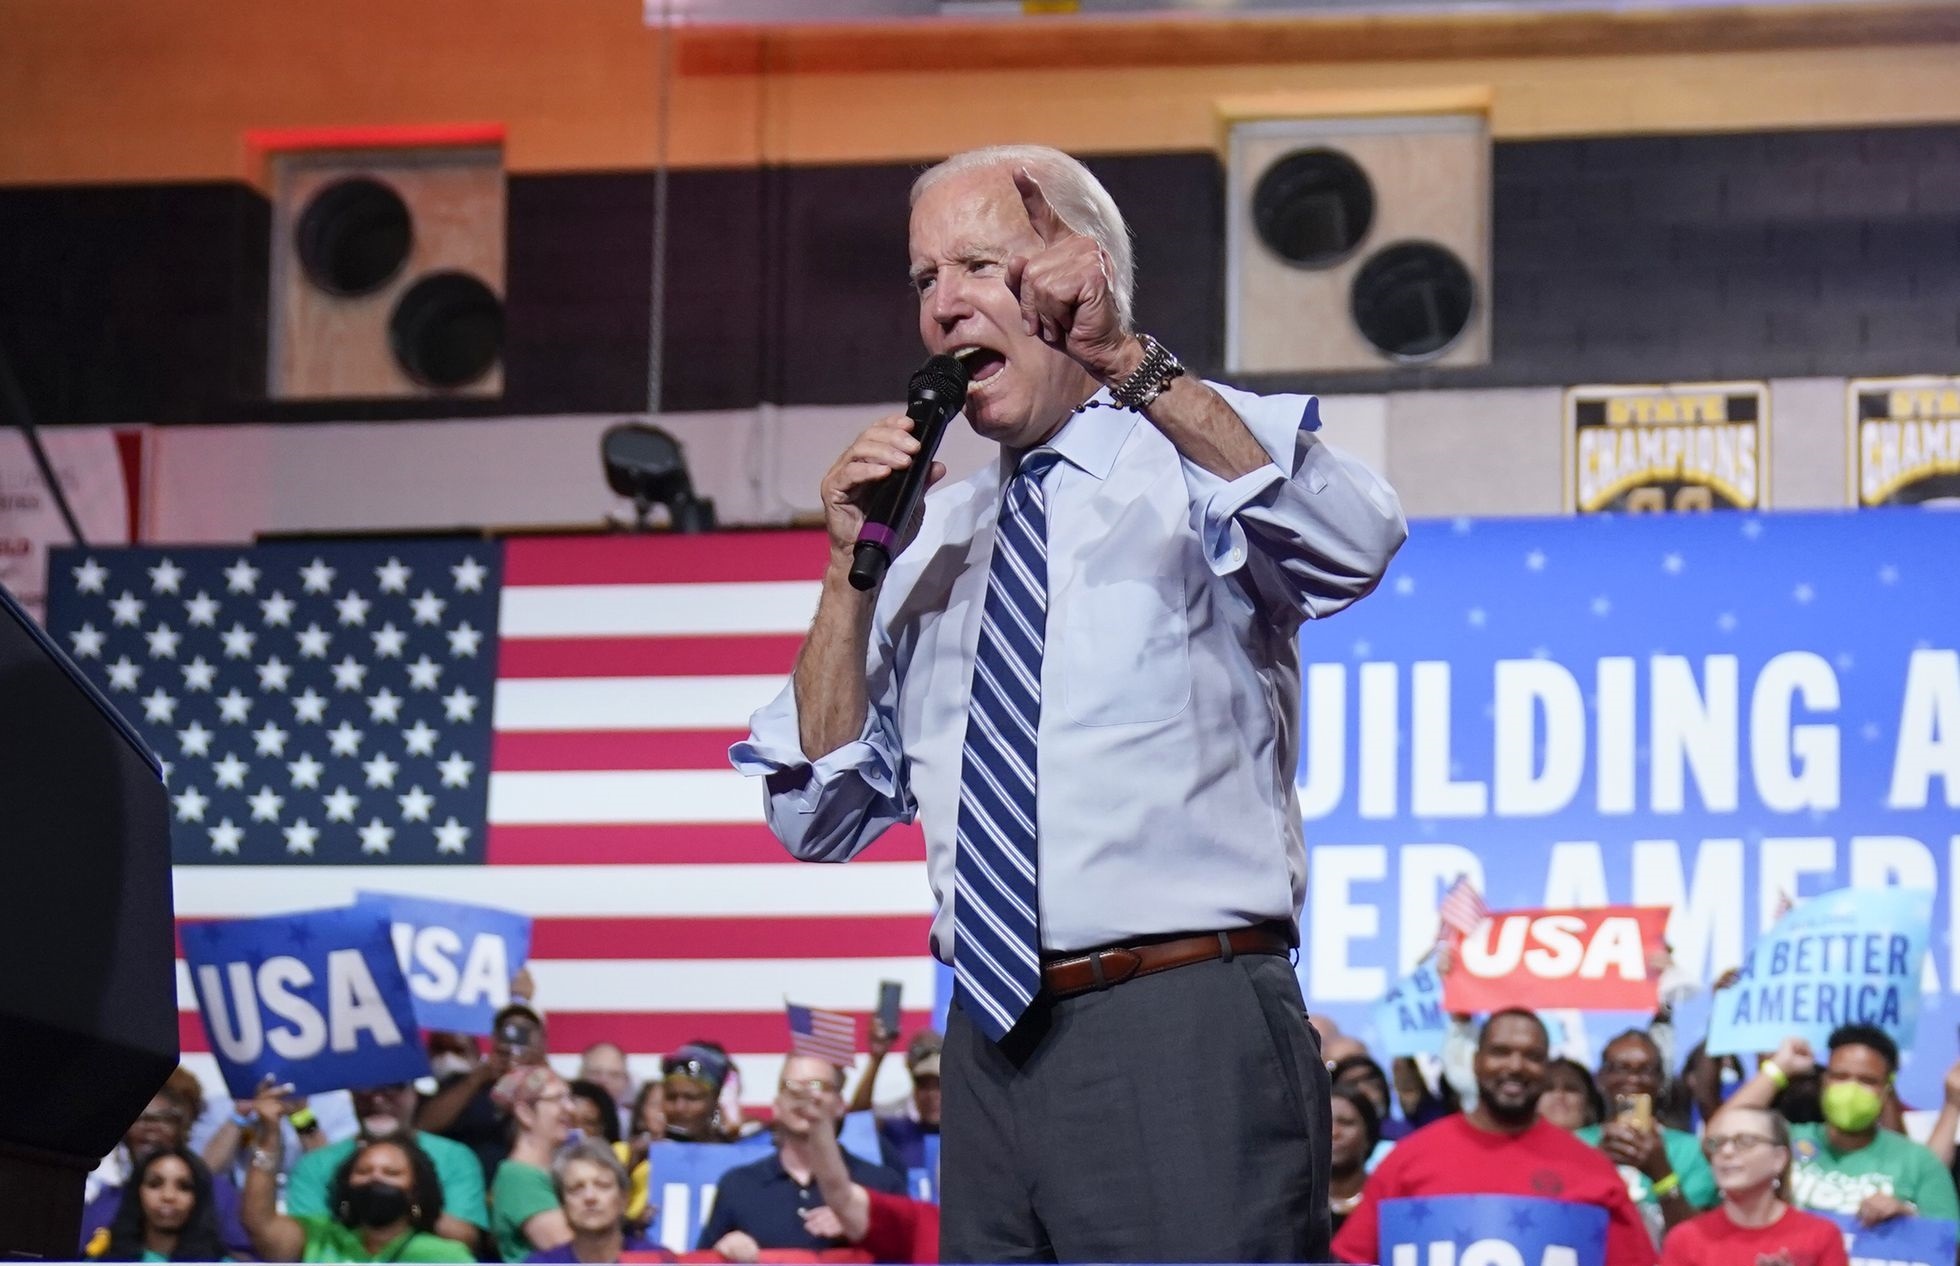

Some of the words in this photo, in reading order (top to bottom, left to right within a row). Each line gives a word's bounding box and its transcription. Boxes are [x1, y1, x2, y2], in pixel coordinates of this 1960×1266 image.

[1607, 395, 1729, 425] STATE
[1576, 424, 1757, 510] CHAMPIONS
[1888, 648, 1960, 809] A
[1460, 915, 1647, 981] USA
[1770, 932, 1910, 977] BETTER
[197, 948, 403, 1064] USA
[1732, 983, 1900, 1026] AMERICA
